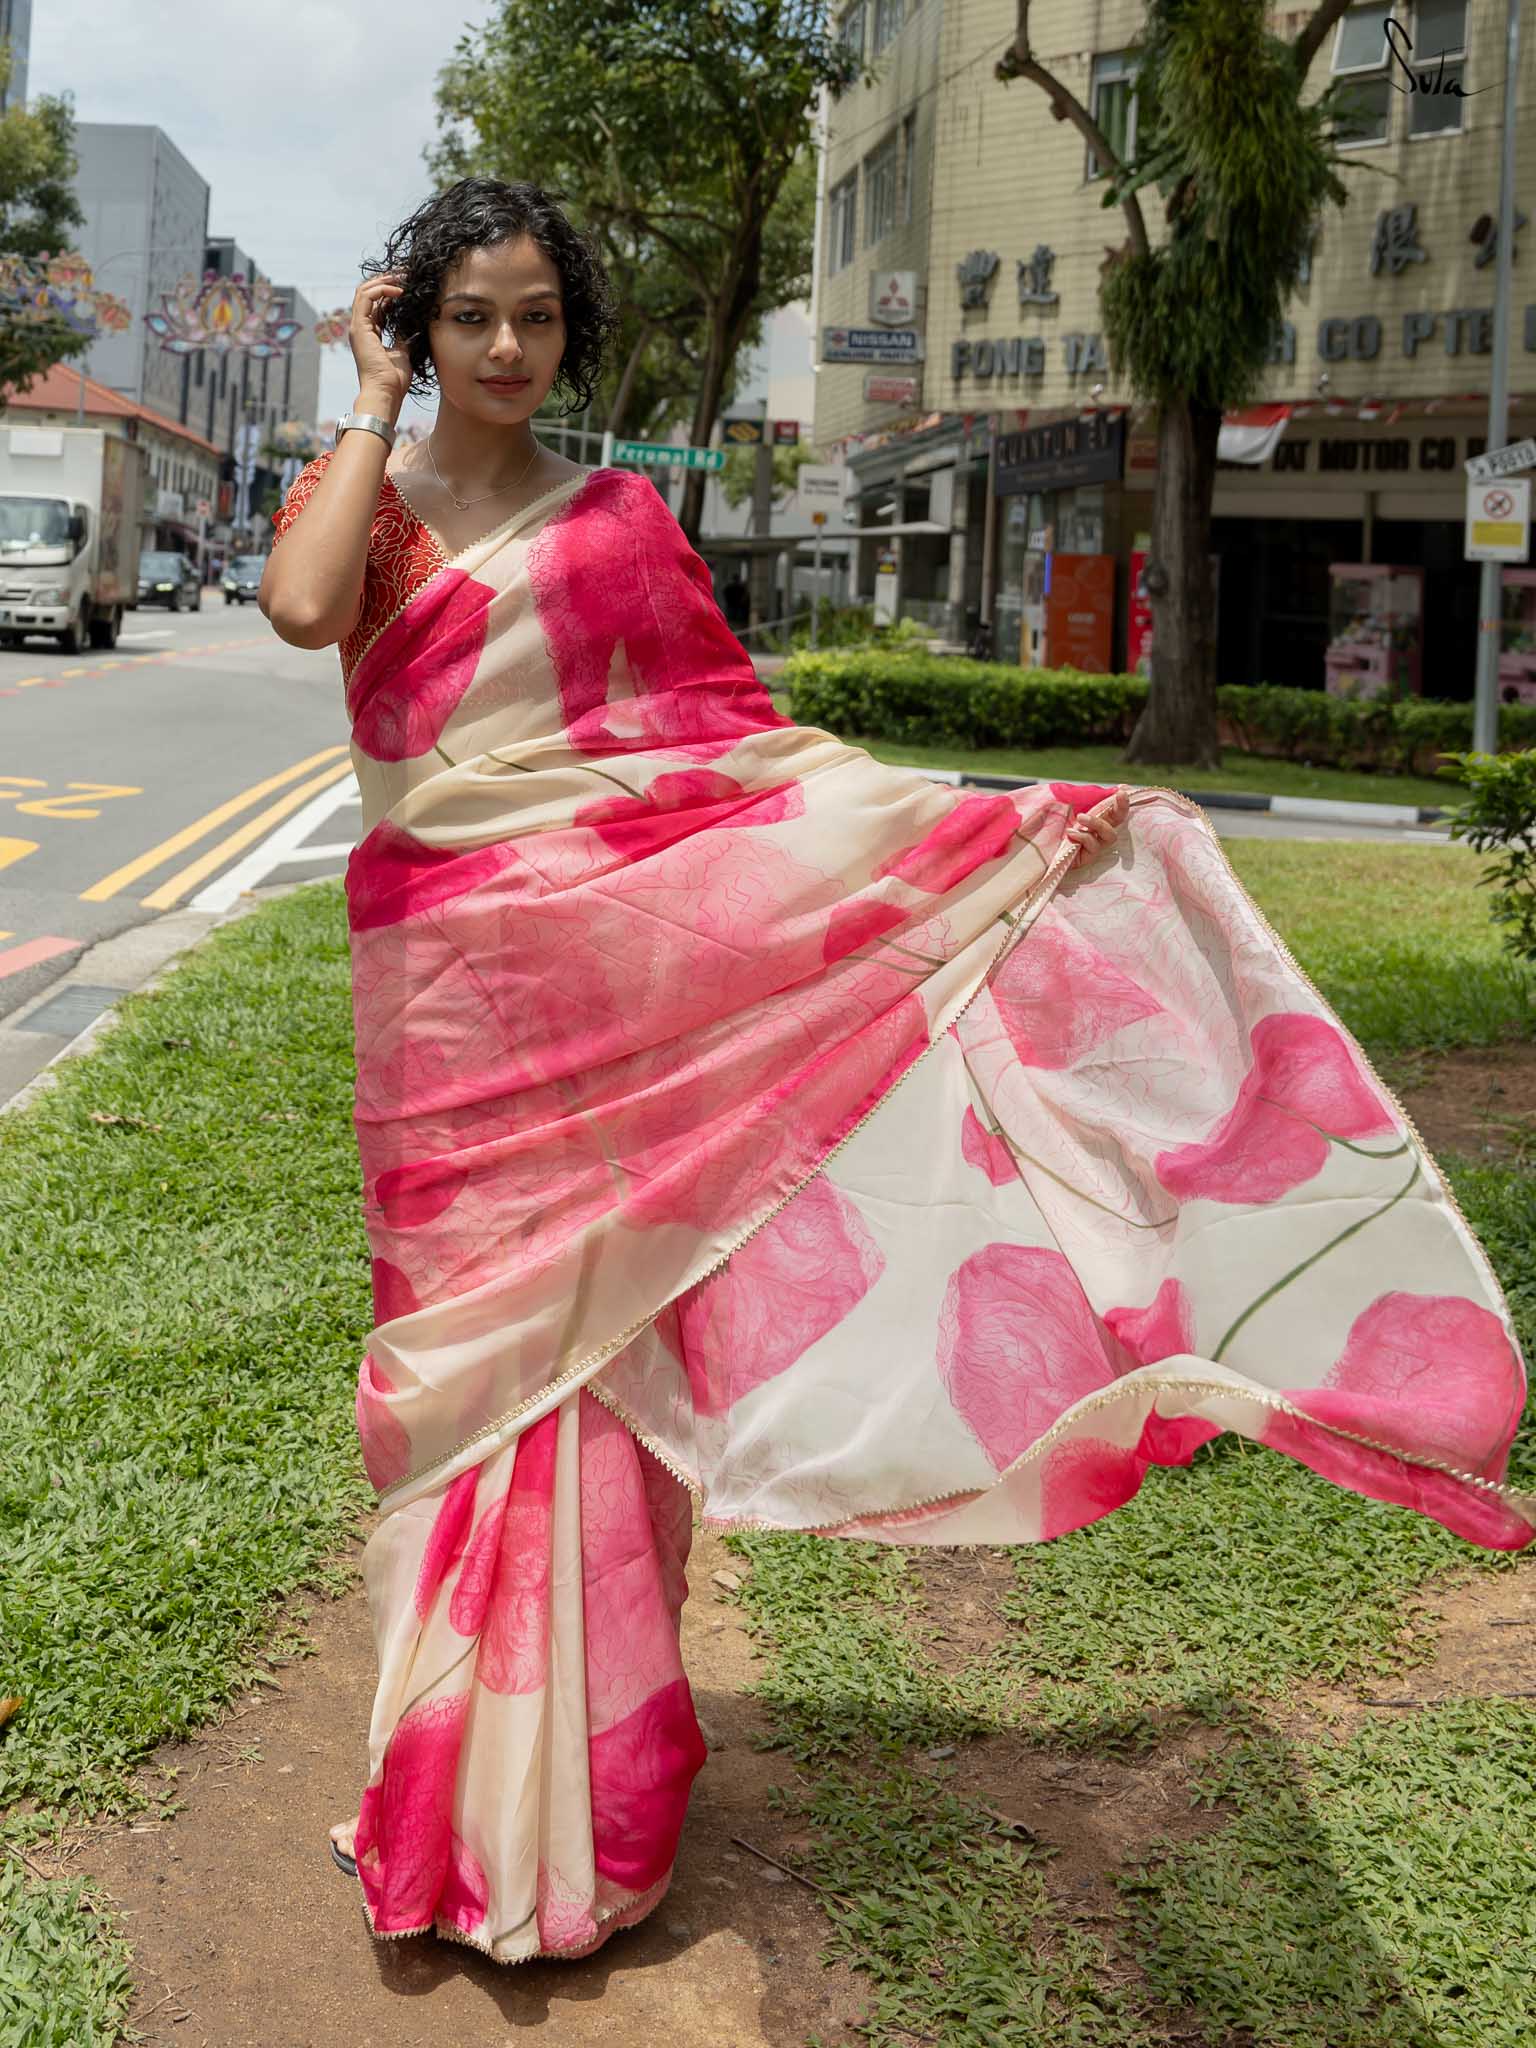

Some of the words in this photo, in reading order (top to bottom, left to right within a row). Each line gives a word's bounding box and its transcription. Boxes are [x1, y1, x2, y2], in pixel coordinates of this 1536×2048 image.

[850, 332, 914, 348] NISSAN
[952, 336, 1045, 381] FONG
[1061, 334, 1109, 374] TA
[1317, 315, 1382, 361] CO
[1403, 306, 1494, 358] PTE
[615, 443, 689, 466] Perumal
[694, 450, 717, 467] Rd
[1319, 438, 1411, 472] MOTOR
[1419, 437, 1457, 472] CO
